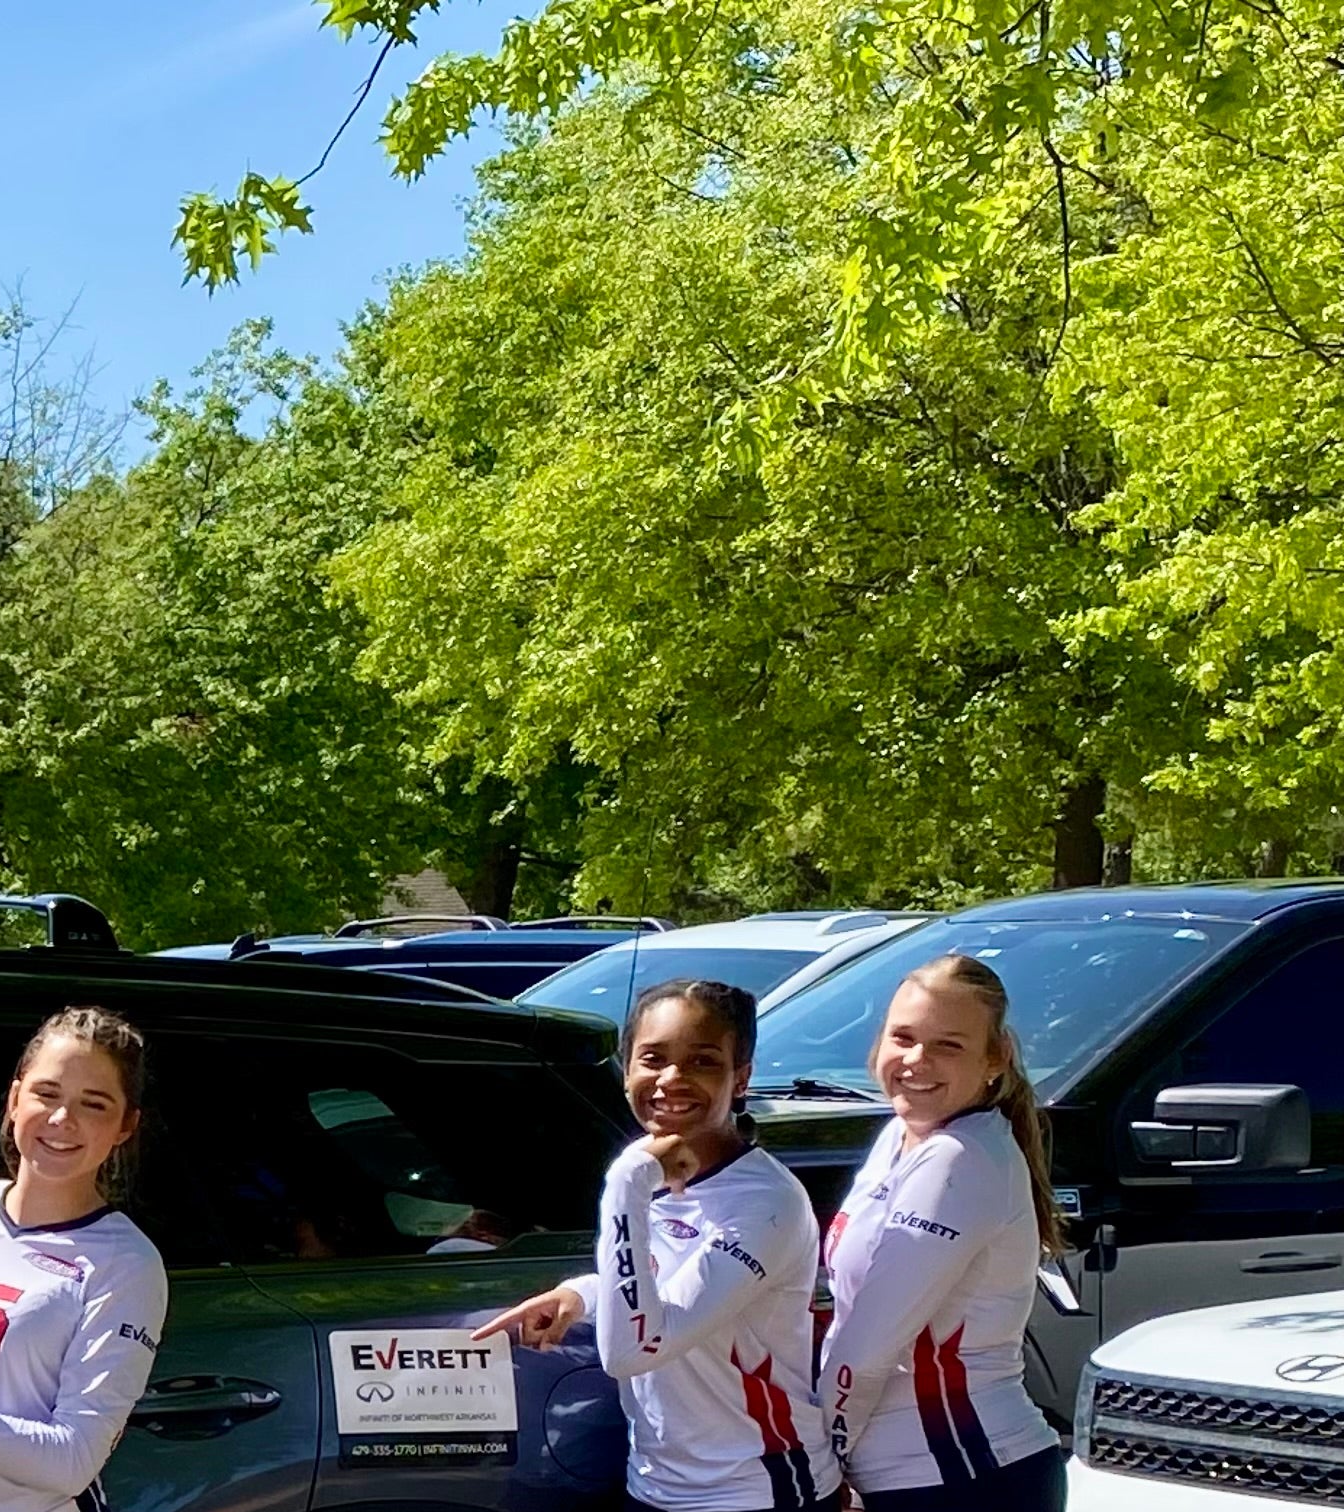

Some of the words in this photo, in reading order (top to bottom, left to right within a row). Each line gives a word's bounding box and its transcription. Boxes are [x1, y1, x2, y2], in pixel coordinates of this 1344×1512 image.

[891, 1210, 961, 1241] EVERETT
[712, 1239, 767, 1281] EVERETT
[351, 1338, 491, 1370] EVERETT
[406, 1385, 497, 1397] INFINITI
[392, 1414, 403, 1422] OF
[404, 1413, 454, 1422] NORTHWEST
[455, 1412, 497, 1421] ARKANSAS
